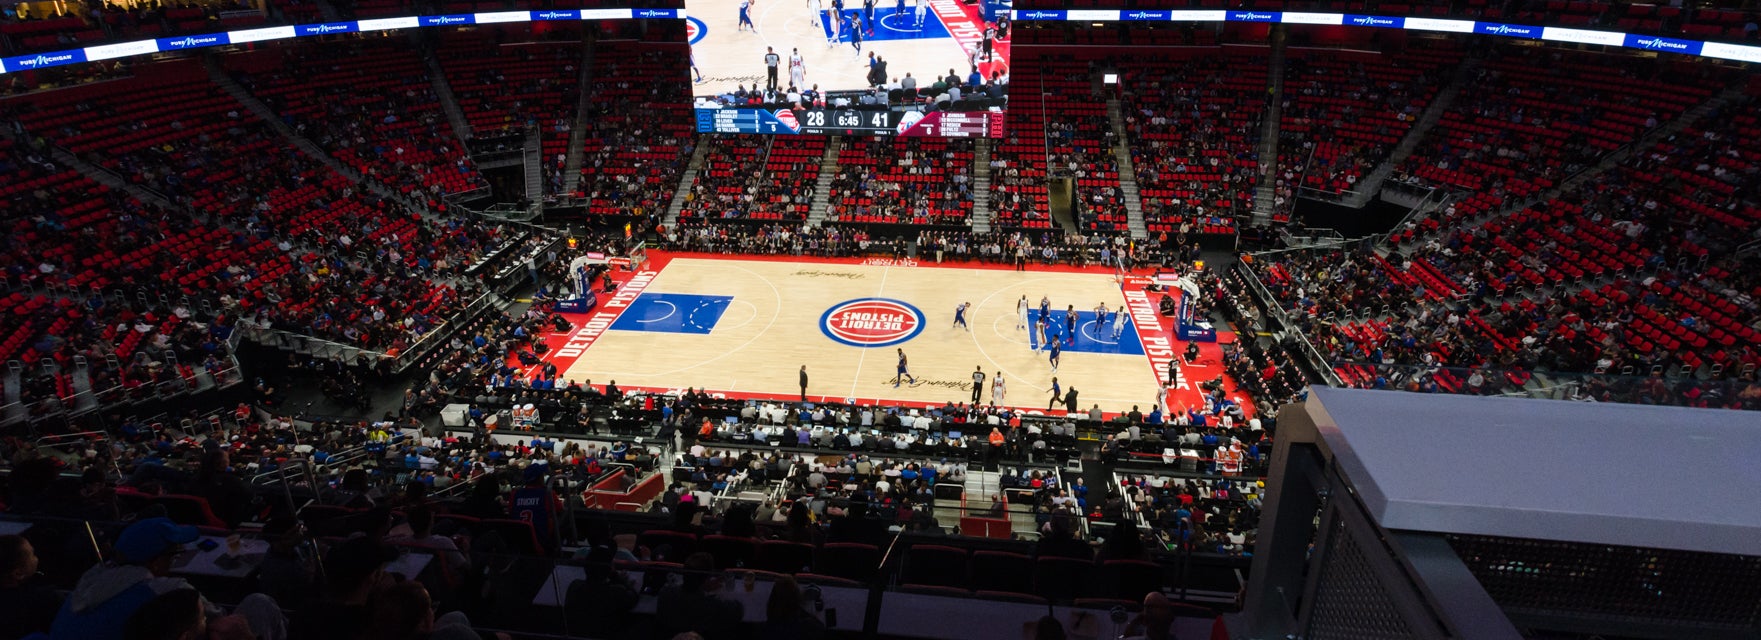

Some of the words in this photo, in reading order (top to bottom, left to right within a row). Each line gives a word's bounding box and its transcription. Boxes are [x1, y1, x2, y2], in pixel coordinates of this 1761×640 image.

[807, 112, 824, 126] 28
[839, 116, 859, 126] 6:45
[872, 112, 888, 127] 41
[554, 312, 617, 358] DETROIT
[604, 271, 657, 308] PISTONS
[842, 312, 904, 322] PISTONS
[1125, 290, 1162, 331] DETROIT
[840, 320, 902, 330] DETROIT
